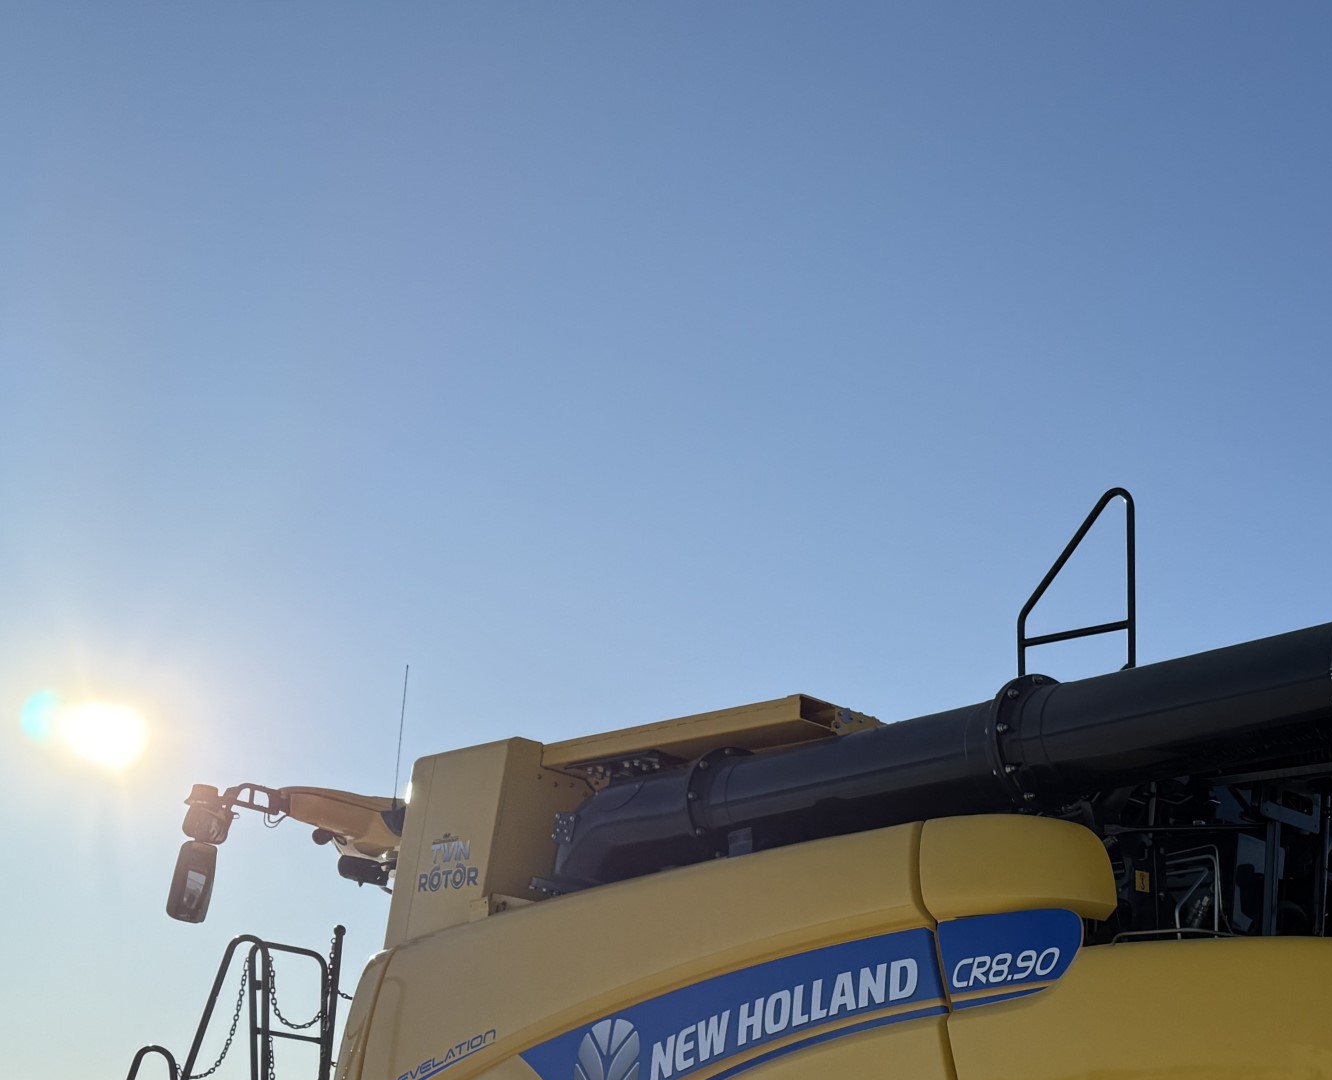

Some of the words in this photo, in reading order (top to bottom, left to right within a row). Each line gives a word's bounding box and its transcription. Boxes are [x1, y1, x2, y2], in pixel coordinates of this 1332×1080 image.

[417, 863, 479, 893] ROTOR
[952, 946, 1060, 988] CR8.90
[737, 957, 918, 1047] HOLLAND
